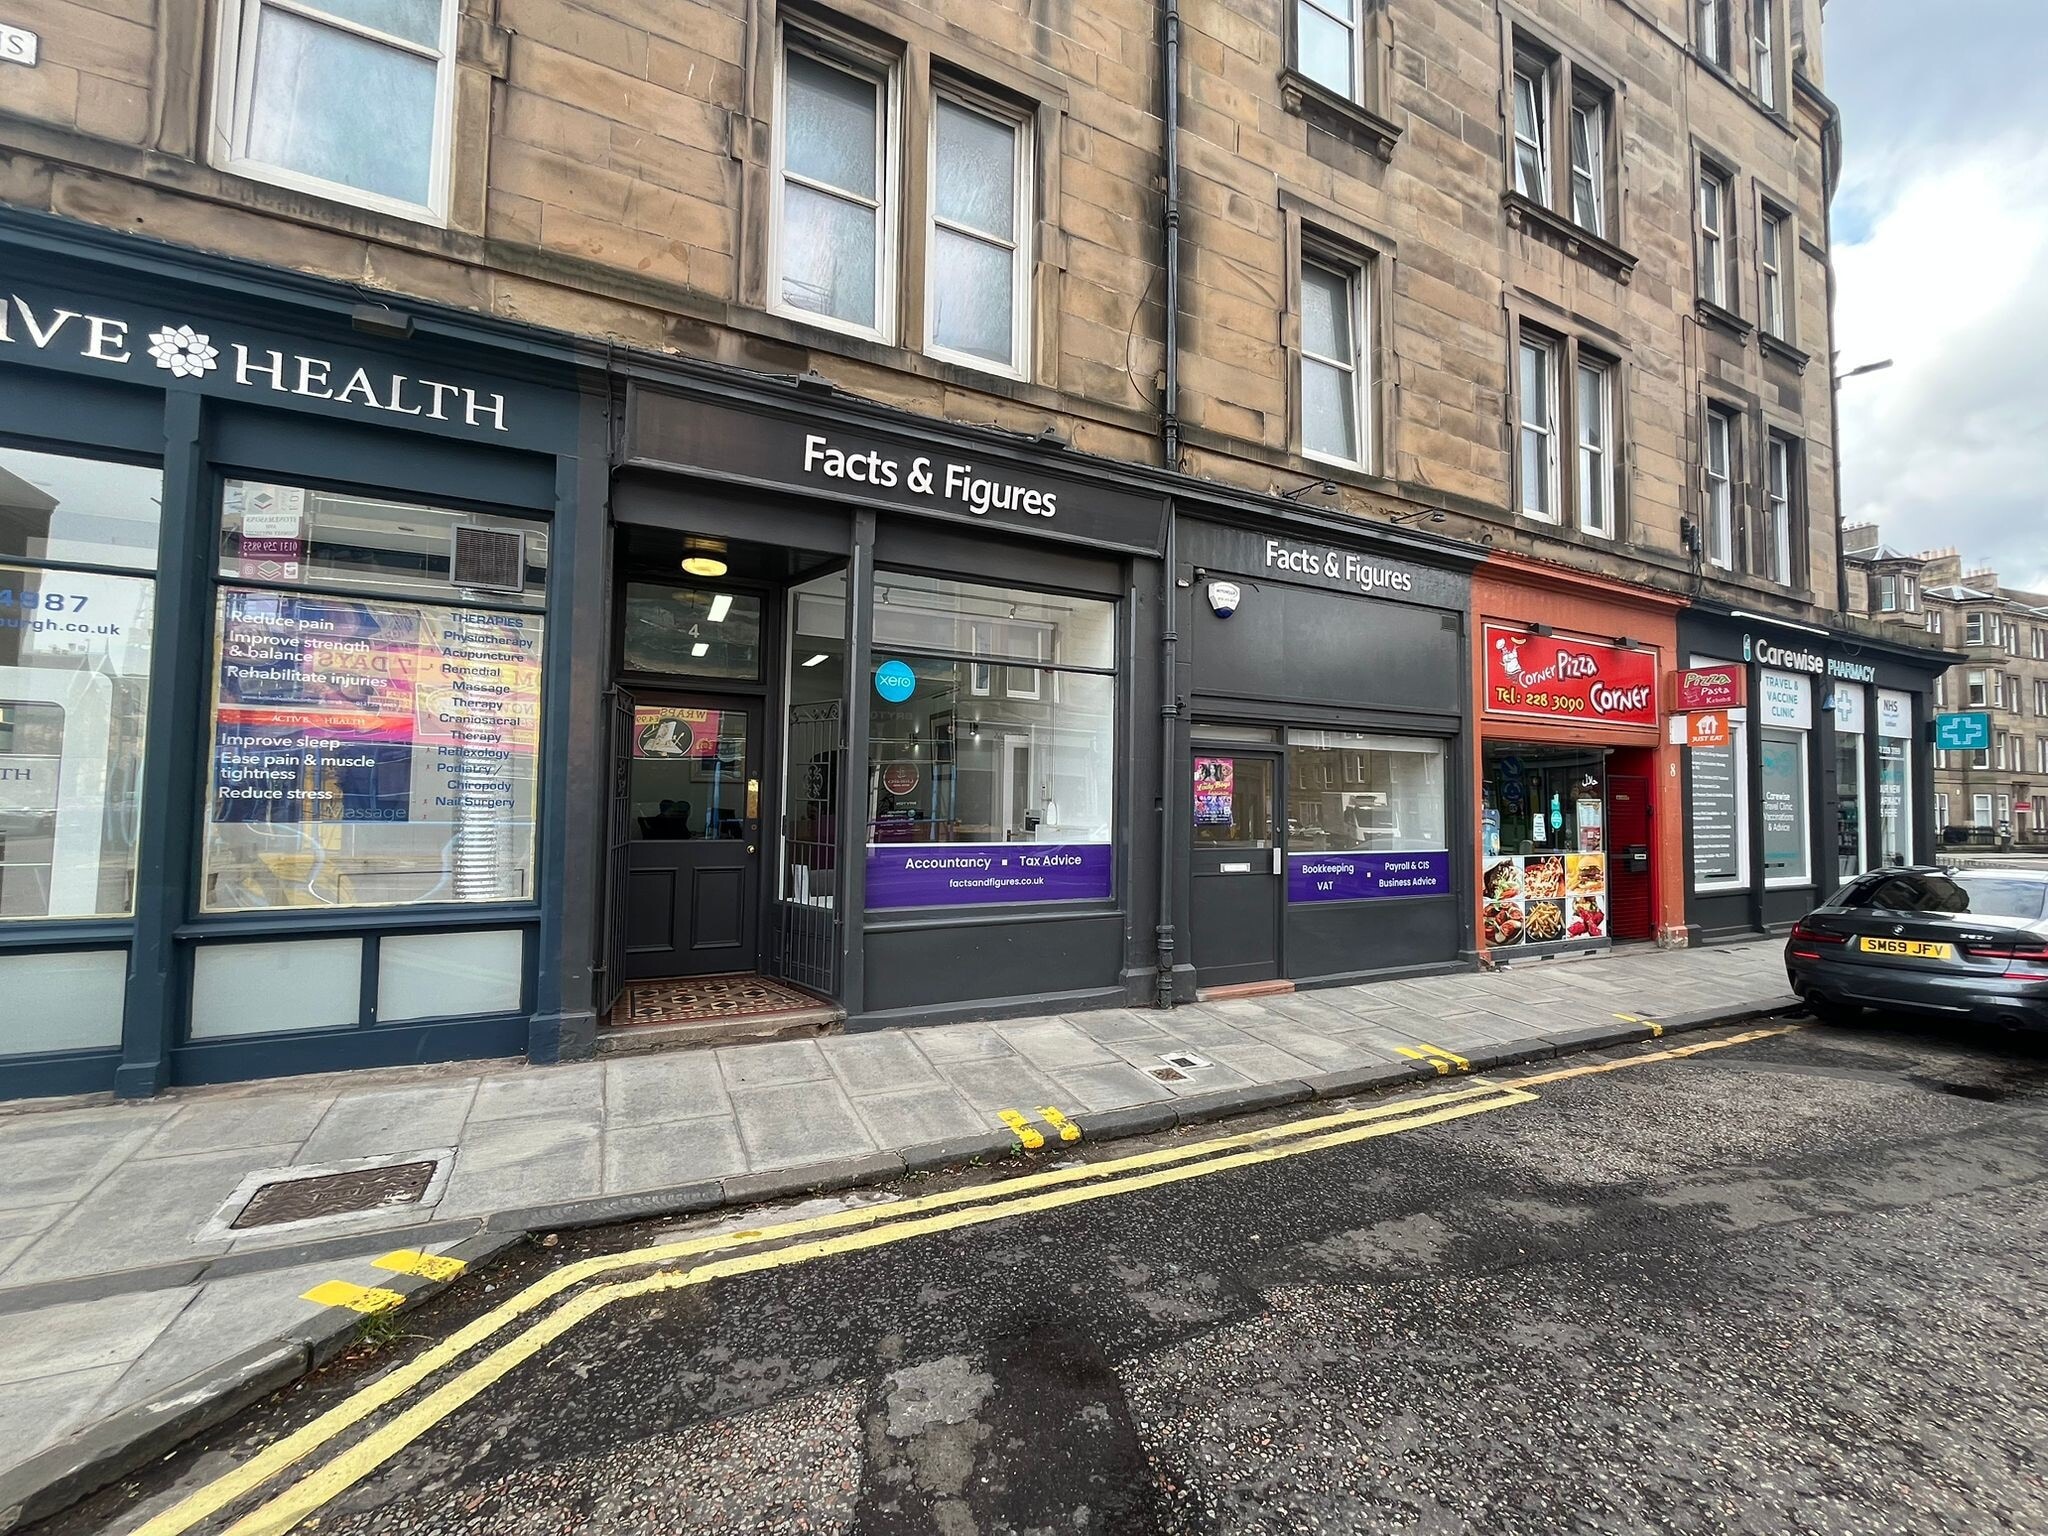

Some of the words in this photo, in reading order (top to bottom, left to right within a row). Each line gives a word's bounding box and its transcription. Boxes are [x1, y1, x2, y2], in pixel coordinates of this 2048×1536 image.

[0, 31, 24, 55] S
[231, 343, 509, 431] HEALTH
[804, 434, 898, 487] Facts
[907, 457, 935, 495] &
[945, 463, 1057, 517] Figures
[1266, 540, 1320, 574] Facts
[1324, 552, 1341, 579] &
[1345, 556, 1412, 591] Figures
[230, 610, 295, 627] Reduce
[299, 618, 334, 632] pain
[451, 612, 524, 628] THERAPIES
[688, 624, 700, 638] 4
[229, 630, 300, 648] Improve
[304, 637, 370, 653] strength
[443, 630, 533, 649] Physiotherapy
[229, 645, 247, 657] &
[248, 647, 313, 662] balance
[442, 647, 524, 662] Acupuncture
[1755, 639, 1823, 673] Carewise
[1827, 659, 1876, 682] PHARMACY
[441, 663, 501, 677] Remedial
[1557, 651, 1598, 681] Pizza
[226, 665, 327, 684] Rehabilitate
[331, 673, 388, 688] injuries
[879, 675, 911, 688] xero
[1684, 673, 1732, 688] Pizza
[1765, 676, 1792, 689] TRAVEL
[452, 680, 511, 695] Massage
[1701, 687, 1730, 695] Pasta
[452, 697, 503, 711] Therapy
[1526, 693, 1548, 707] 228
[1551, 696, 1585, 713] 3090
[1767, 691, 1798, 704] VACCINE
[1771, 706, 1795, 718] CLINIC
[1883, 699, 1898, 712] NHS
[439, 713, 520, 726] Craniosacral
[221, 733, 293, 748] Improve
[296, 735, 340, 751] sleep
[450, 730, 502, 742] Therapy
[220, 751, 261, 765] Ease
[264, 753, 300, 768] pain
[303, 754, 317, 767] &
[321, 755, 375, 767] muscle
[437, 746, 510, 760] Reflexology
[220, 766, 296, 782] tightness
[437, 763, 492, 775] Podiatry
[1670, 763, 1676, 777] 8
[218, 786, 283, 799] Reduce
[286, 788, 334, 800] stress
[447, 780, 512, 793] Chiropody
[435, 796, 462, 807] Nail
[464, 797, 515, 808] Surgery
[905, 857, 992, 871] Accountancy
[1019, 855, 1041, 866] Tax
[1043, 854, 1082, 866] Advice
[1302, 863, 1355, 875] Bookkeeping
[1384, 861, 1410, 872] Payroll
[1411, 862, 1417, 870] &
[1418, 861, 1430, 869] CIS
[949, 877, 1044, 888] factsandfigures.co.uk
[1317, 881, 1334, 891] VAT
[1379, 878, 1411, 888] Business
[1412, 877, 1437, 886] Advice
[1868, 939, 1907, 953] SM69
[1912, 943, 1943, 956] JFV
